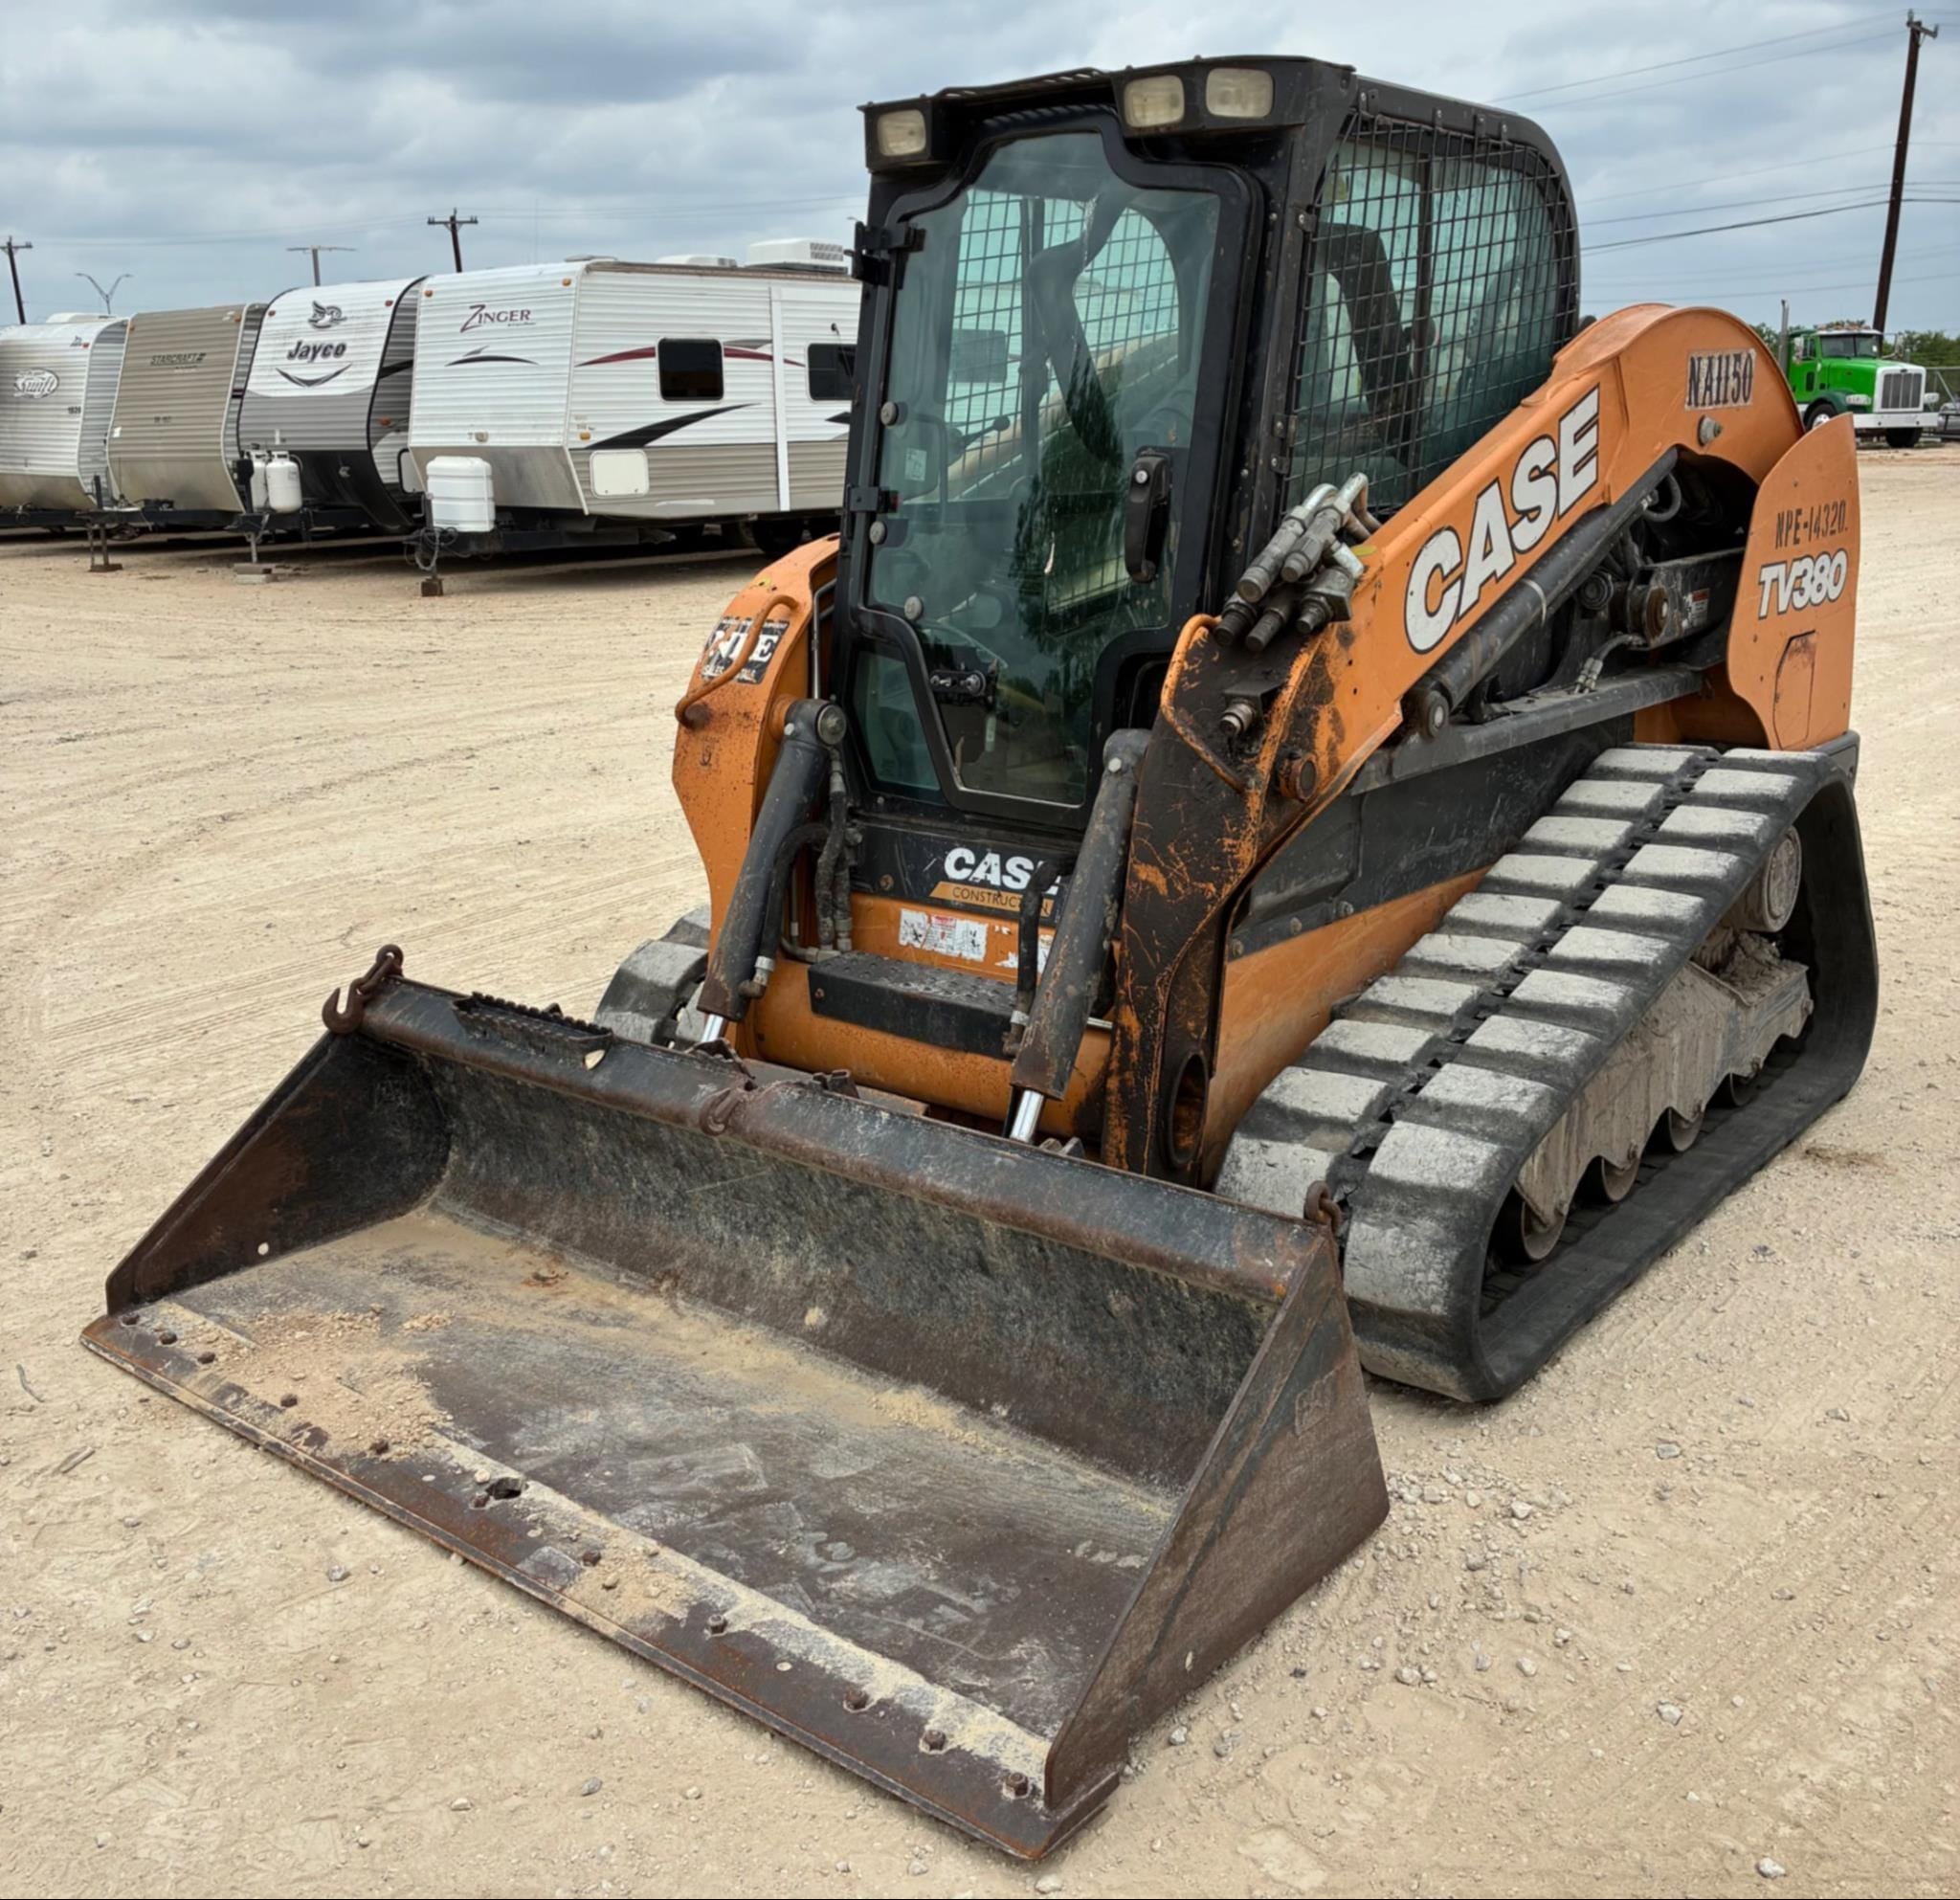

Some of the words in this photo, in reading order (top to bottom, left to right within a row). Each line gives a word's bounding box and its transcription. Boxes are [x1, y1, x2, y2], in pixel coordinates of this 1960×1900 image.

[287, 340, 347, 364] Jayco
[1404, 383, 1600, 655] CASE
[1758, 548, 1848, 620] TV380
[944, 847, 1062, 896] CAS
[952, 886, 1052, 916] CONSTRUCN
